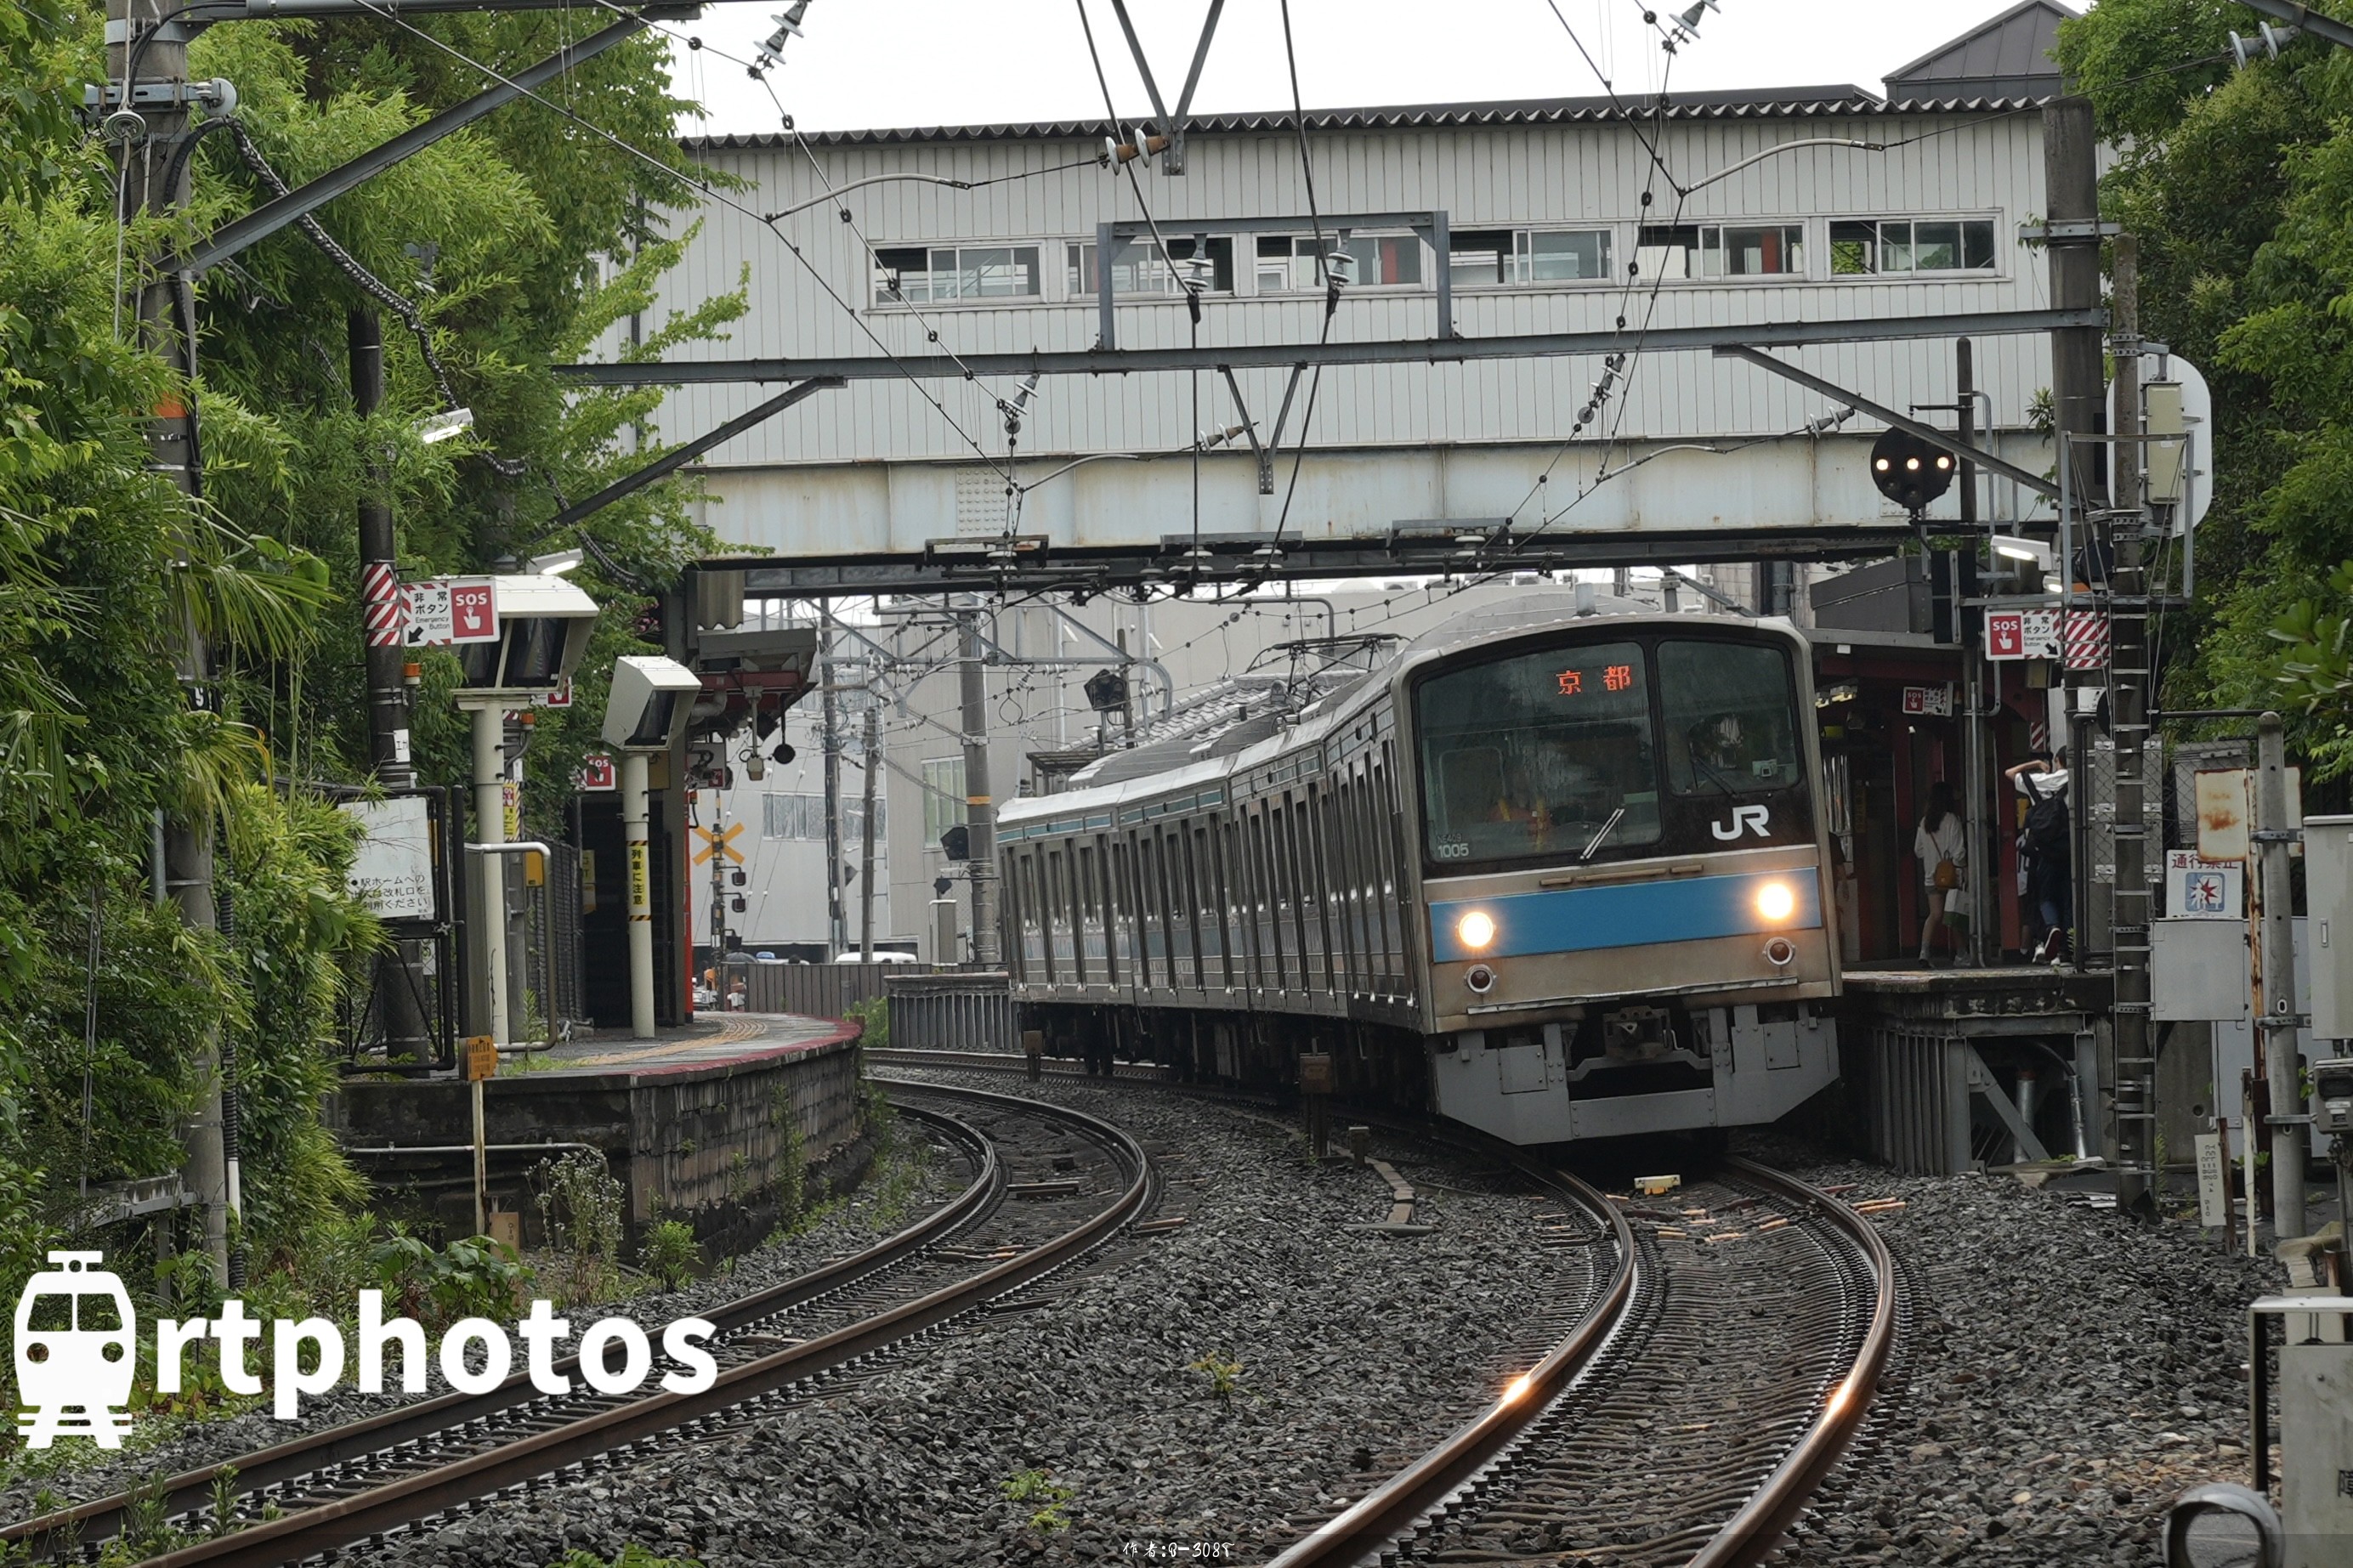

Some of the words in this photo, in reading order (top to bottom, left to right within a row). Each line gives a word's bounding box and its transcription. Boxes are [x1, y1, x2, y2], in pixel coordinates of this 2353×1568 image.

[414, 592, 447, 603] 非常
[456, 592, 487, 606] SOS
[415, 604, 448, 614] ボタン
[1993, 620, 2018, 631] SOS
[2024, 616, 2049, 625] 非常
[1556, 665, 1631, 694] 京都
[1711, 804, 1771, 841] JR
[1437, 843, 1469, 858] 1005
[360, 875, 425, 887] 駅ホームへの
[632, 850, 643, 904] 列車に注意
